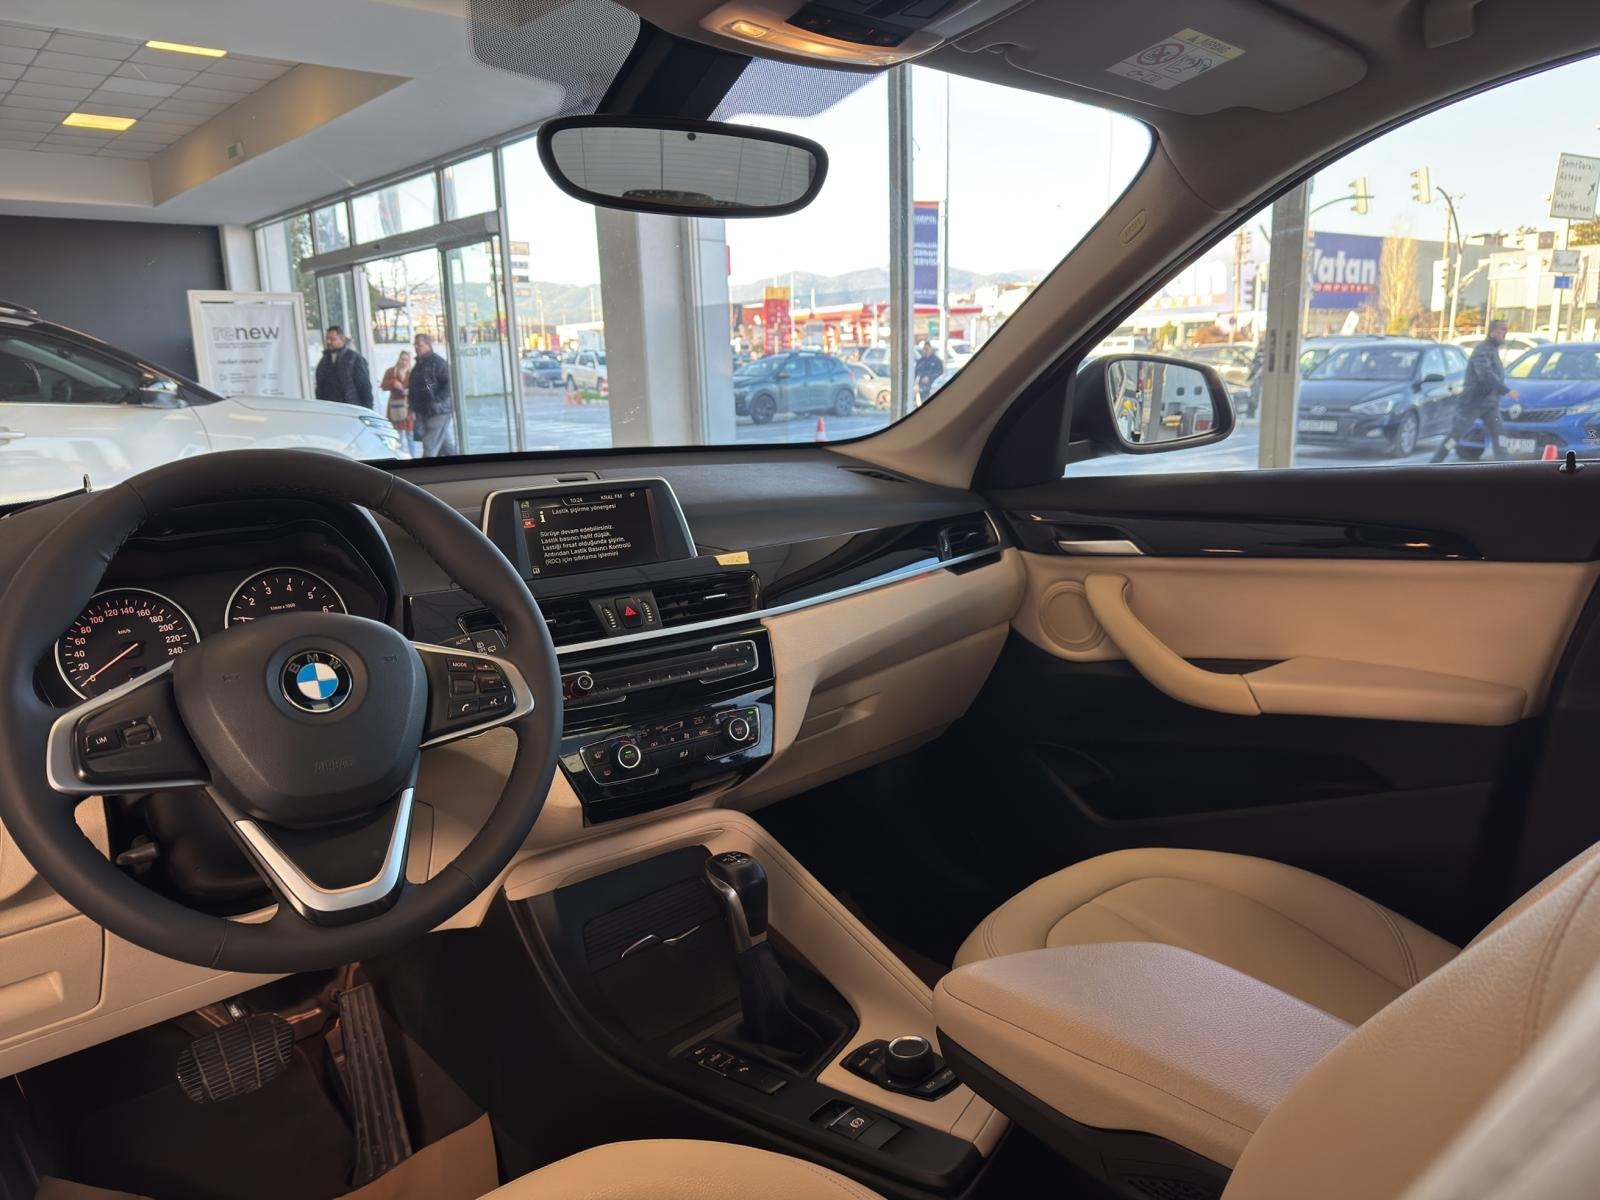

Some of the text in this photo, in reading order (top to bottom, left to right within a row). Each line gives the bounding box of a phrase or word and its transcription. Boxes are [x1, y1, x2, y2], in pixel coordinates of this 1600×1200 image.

[212, 326, 280, 340] renew
[591, 503, 616, 513] yönergesi
[540, 530, 560, 538] Sürüşe
[578, 539, 607, 547] olduğunda
[249, 598, 256, 606] 2
[120, 606, 134, 614] 140
[90, 616, 104, 624] 100
[158, 624, 173, 632] 200
[166, 635, 180, 643] 220
[168, 647, 182, 655] 240
[288, 653, 342, 674] BMW
